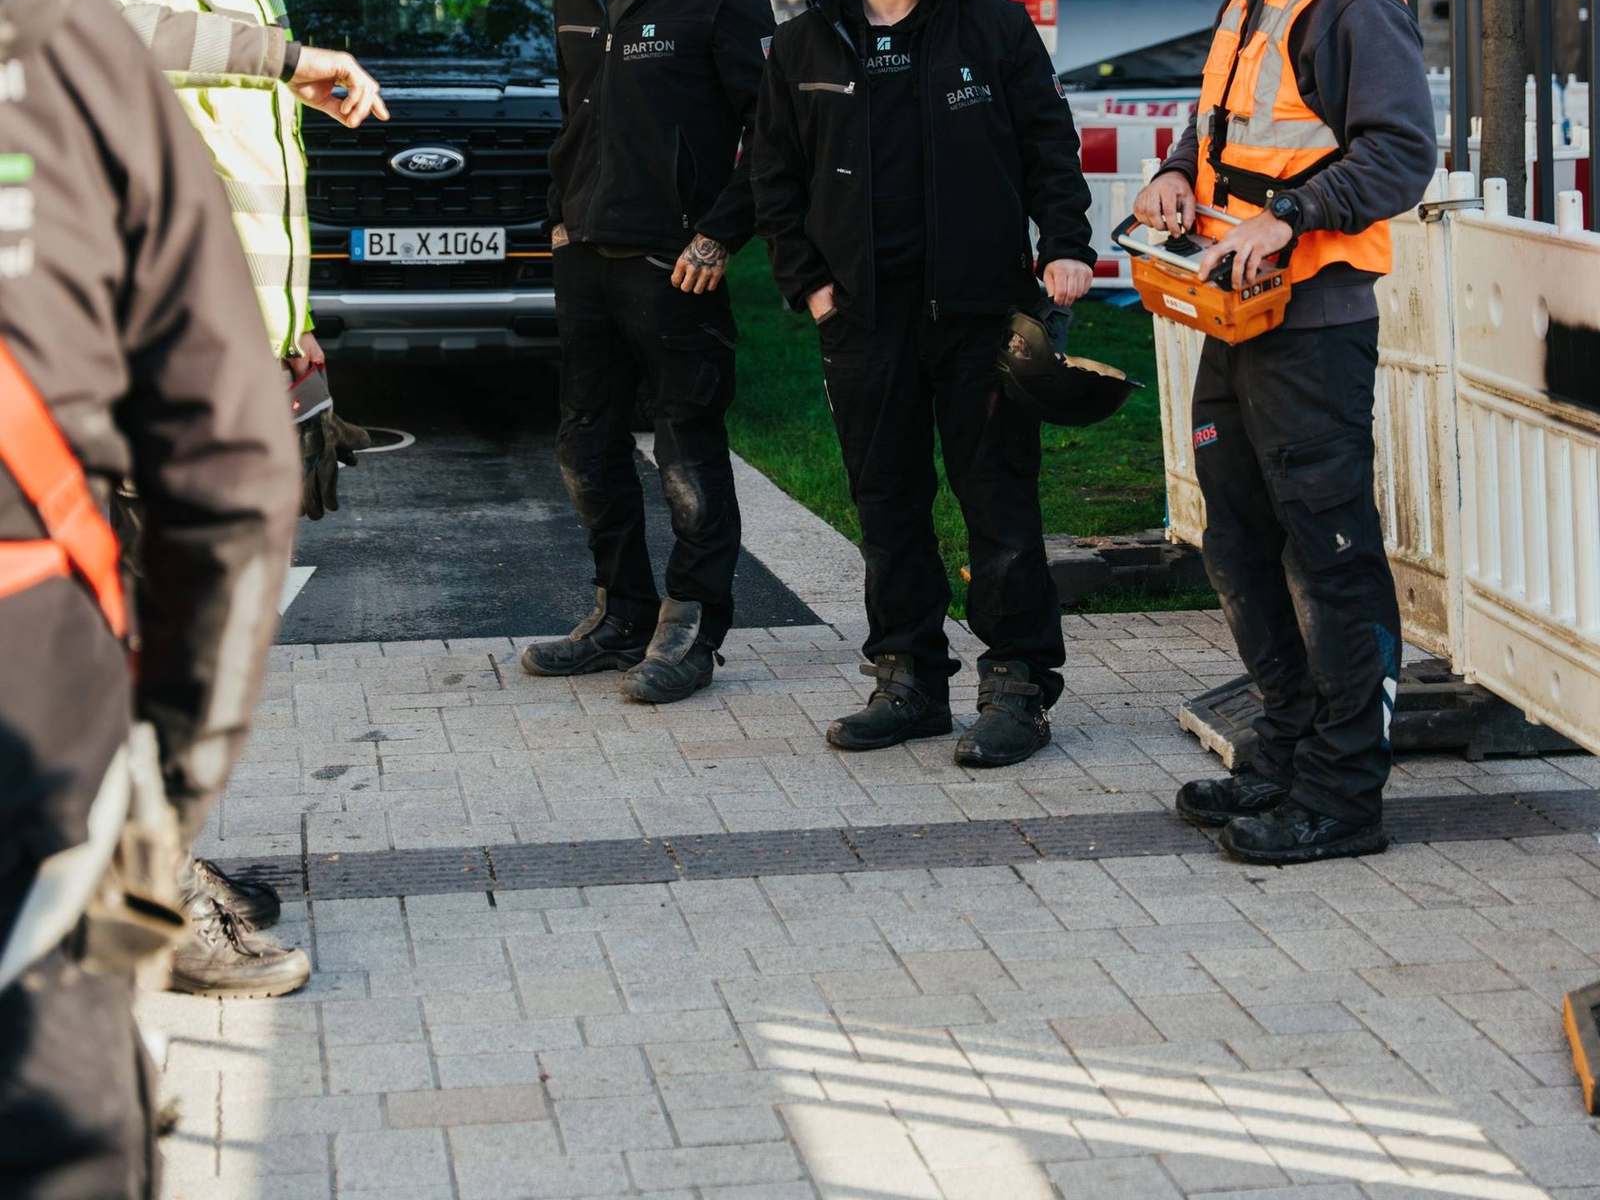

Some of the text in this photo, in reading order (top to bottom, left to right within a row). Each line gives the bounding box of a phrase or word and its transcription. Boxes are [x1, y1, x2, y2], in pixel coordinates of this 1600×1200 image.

[624, 40, 675, 55] BARTON
[862, 53, 911, 68] ARTON
[408, 154, 449, 170] Ford
[369, 233, 398, 255] BI
